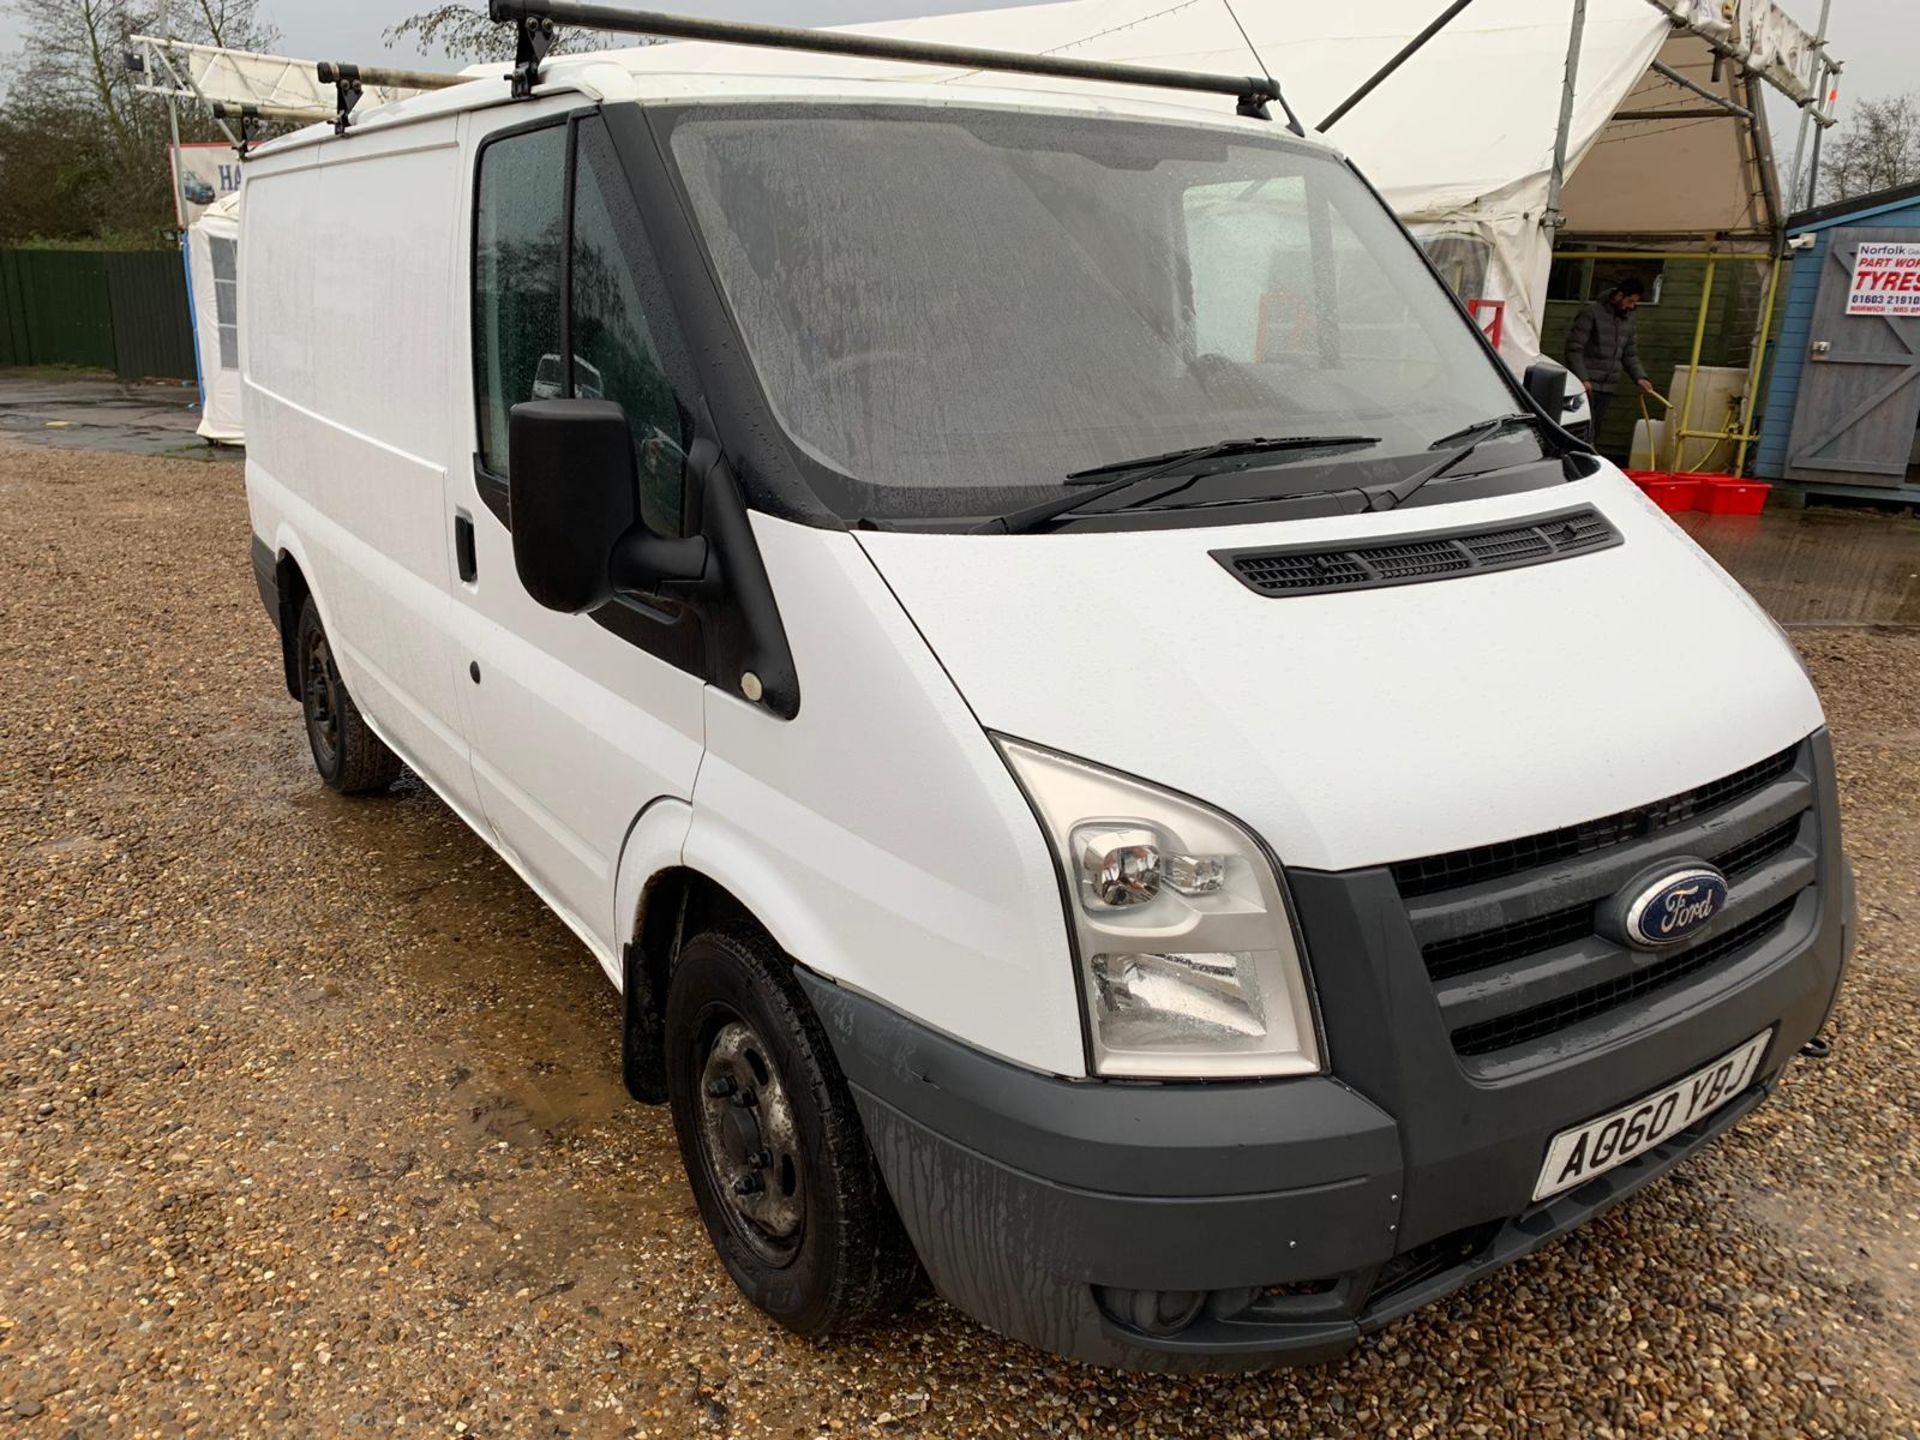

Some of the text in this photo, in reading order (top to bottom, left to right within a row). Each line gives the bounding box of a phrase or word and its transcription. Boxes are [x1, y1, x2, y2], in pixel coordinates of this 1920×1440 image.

[1860, 245, 1905, 255] Norfolk
[1858, 257, 1893, 267] PART
[1852, 295, 1884, 304] 01603
[1661, 885, 1713, 933] Ford
[1684, 1044, 1758, 1122] YBJ
